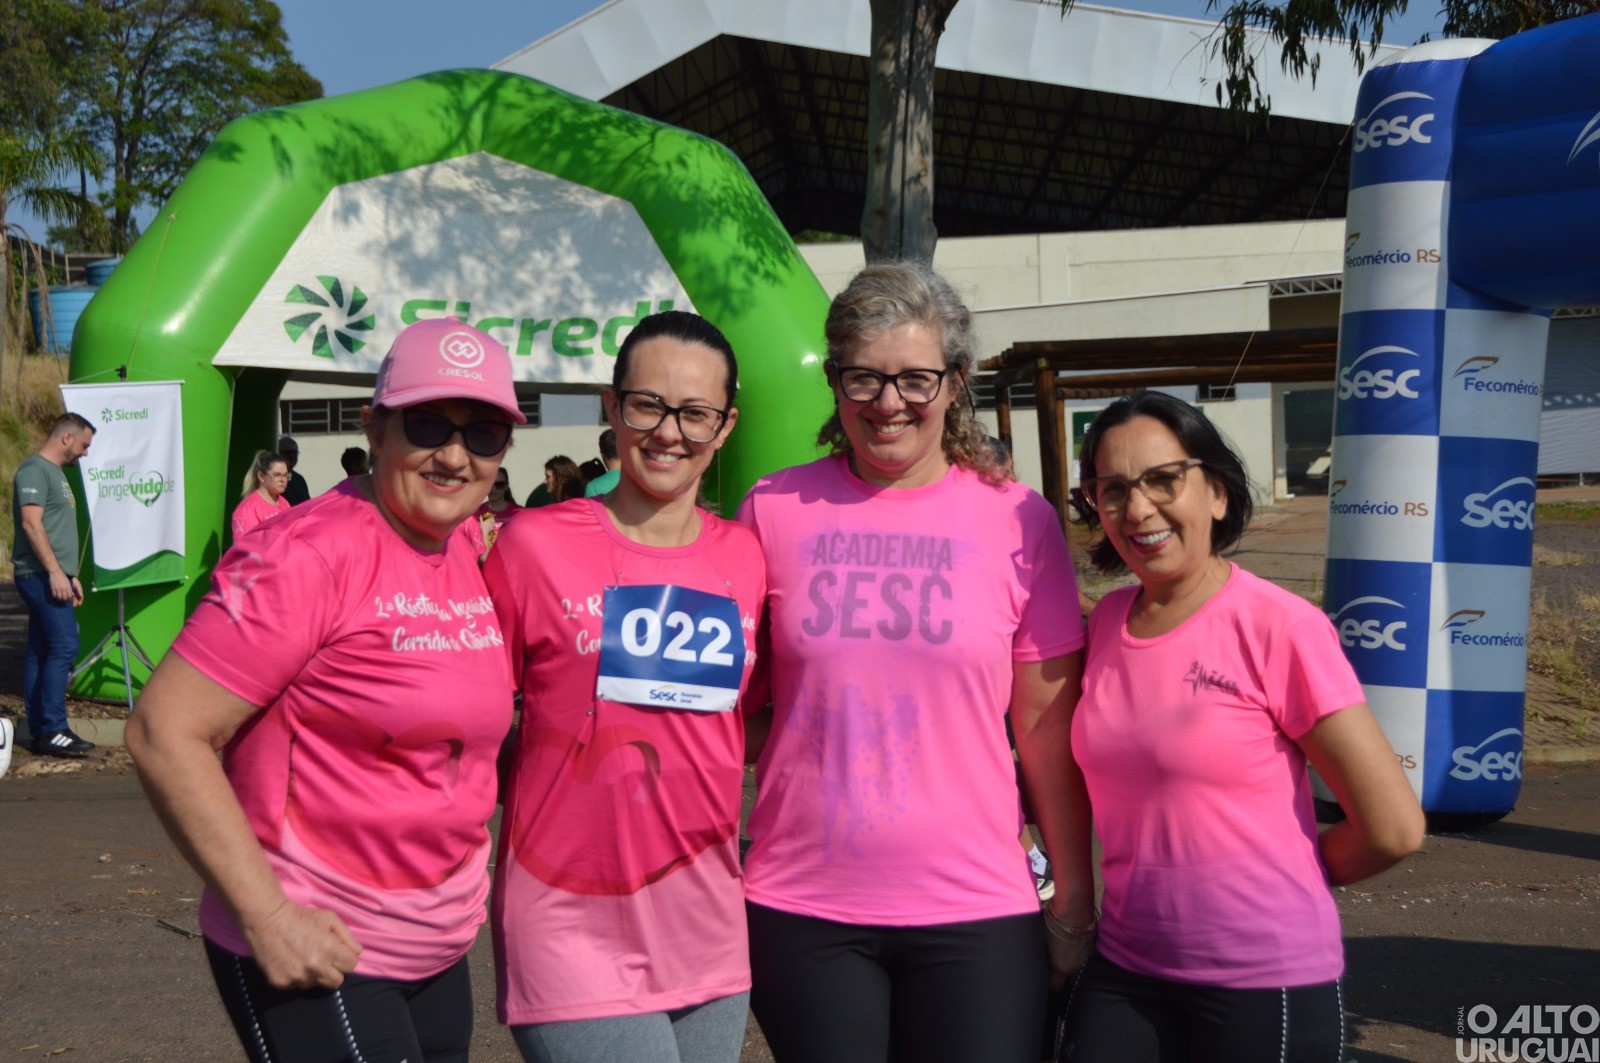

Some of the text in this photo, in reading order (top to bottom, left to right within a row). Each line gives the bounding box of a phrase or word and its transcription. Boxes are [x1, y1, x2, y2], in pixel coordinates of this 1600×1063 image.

[1416, 248, 1441, 264] RS
[437, 368, 485, 382] CRESOL
[1337, 366, 1421, 400] Sesc
[1464, 377, 1539, 397] Fecomércio
[115, 408, 149, 421] Sicredi
[88, 465, 125, 481] Sicredi
[1404, 502, 1429, 517] RS
[811, 532, 953, 571] ACADEMIA
[801, 569, 953, 645] SESC
[621, 607, 735, 667] 022
[1328, 612, 1408, 651] esc
[1451, 630, 1524, 647] Fecomércio
